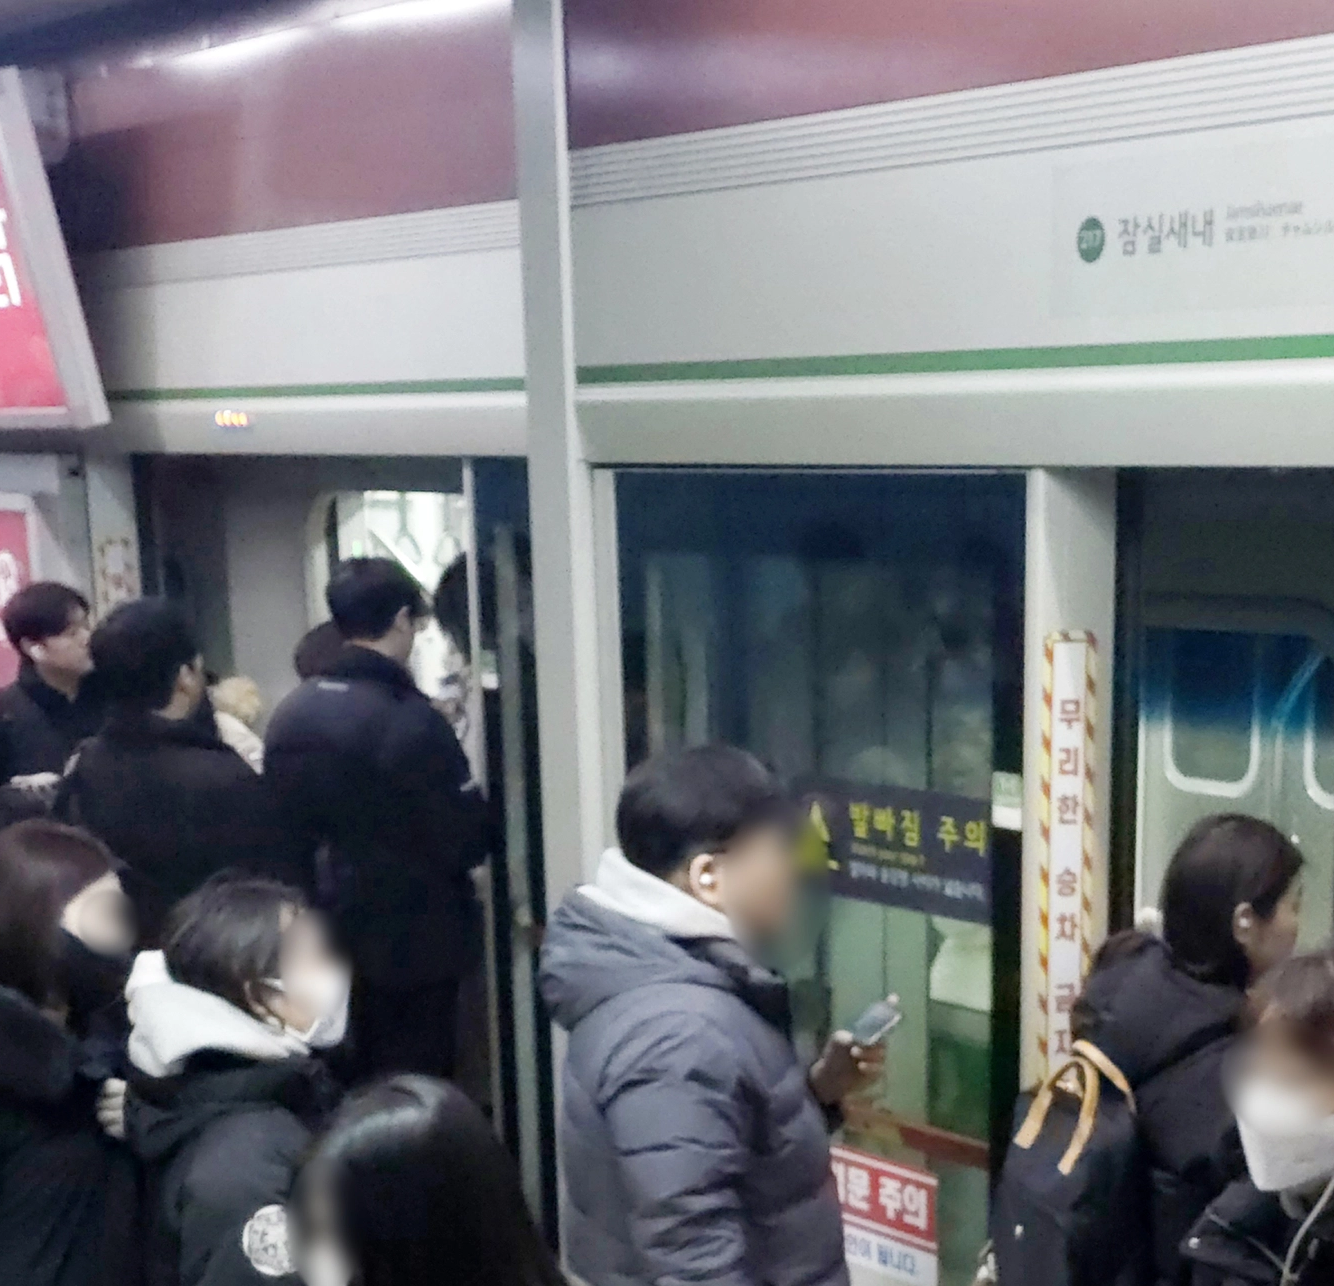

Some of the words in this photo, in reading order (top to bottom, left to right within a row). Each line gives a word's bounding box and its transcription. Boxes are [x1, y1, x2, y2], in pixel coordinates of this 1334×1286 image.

[1117, 208, 1215, 256] 잠실새내
[848, 802, 921, 847] 발빠짐
[936, 815, 987, 858] 주의
[878, 1175, 928, 1231] 주의
